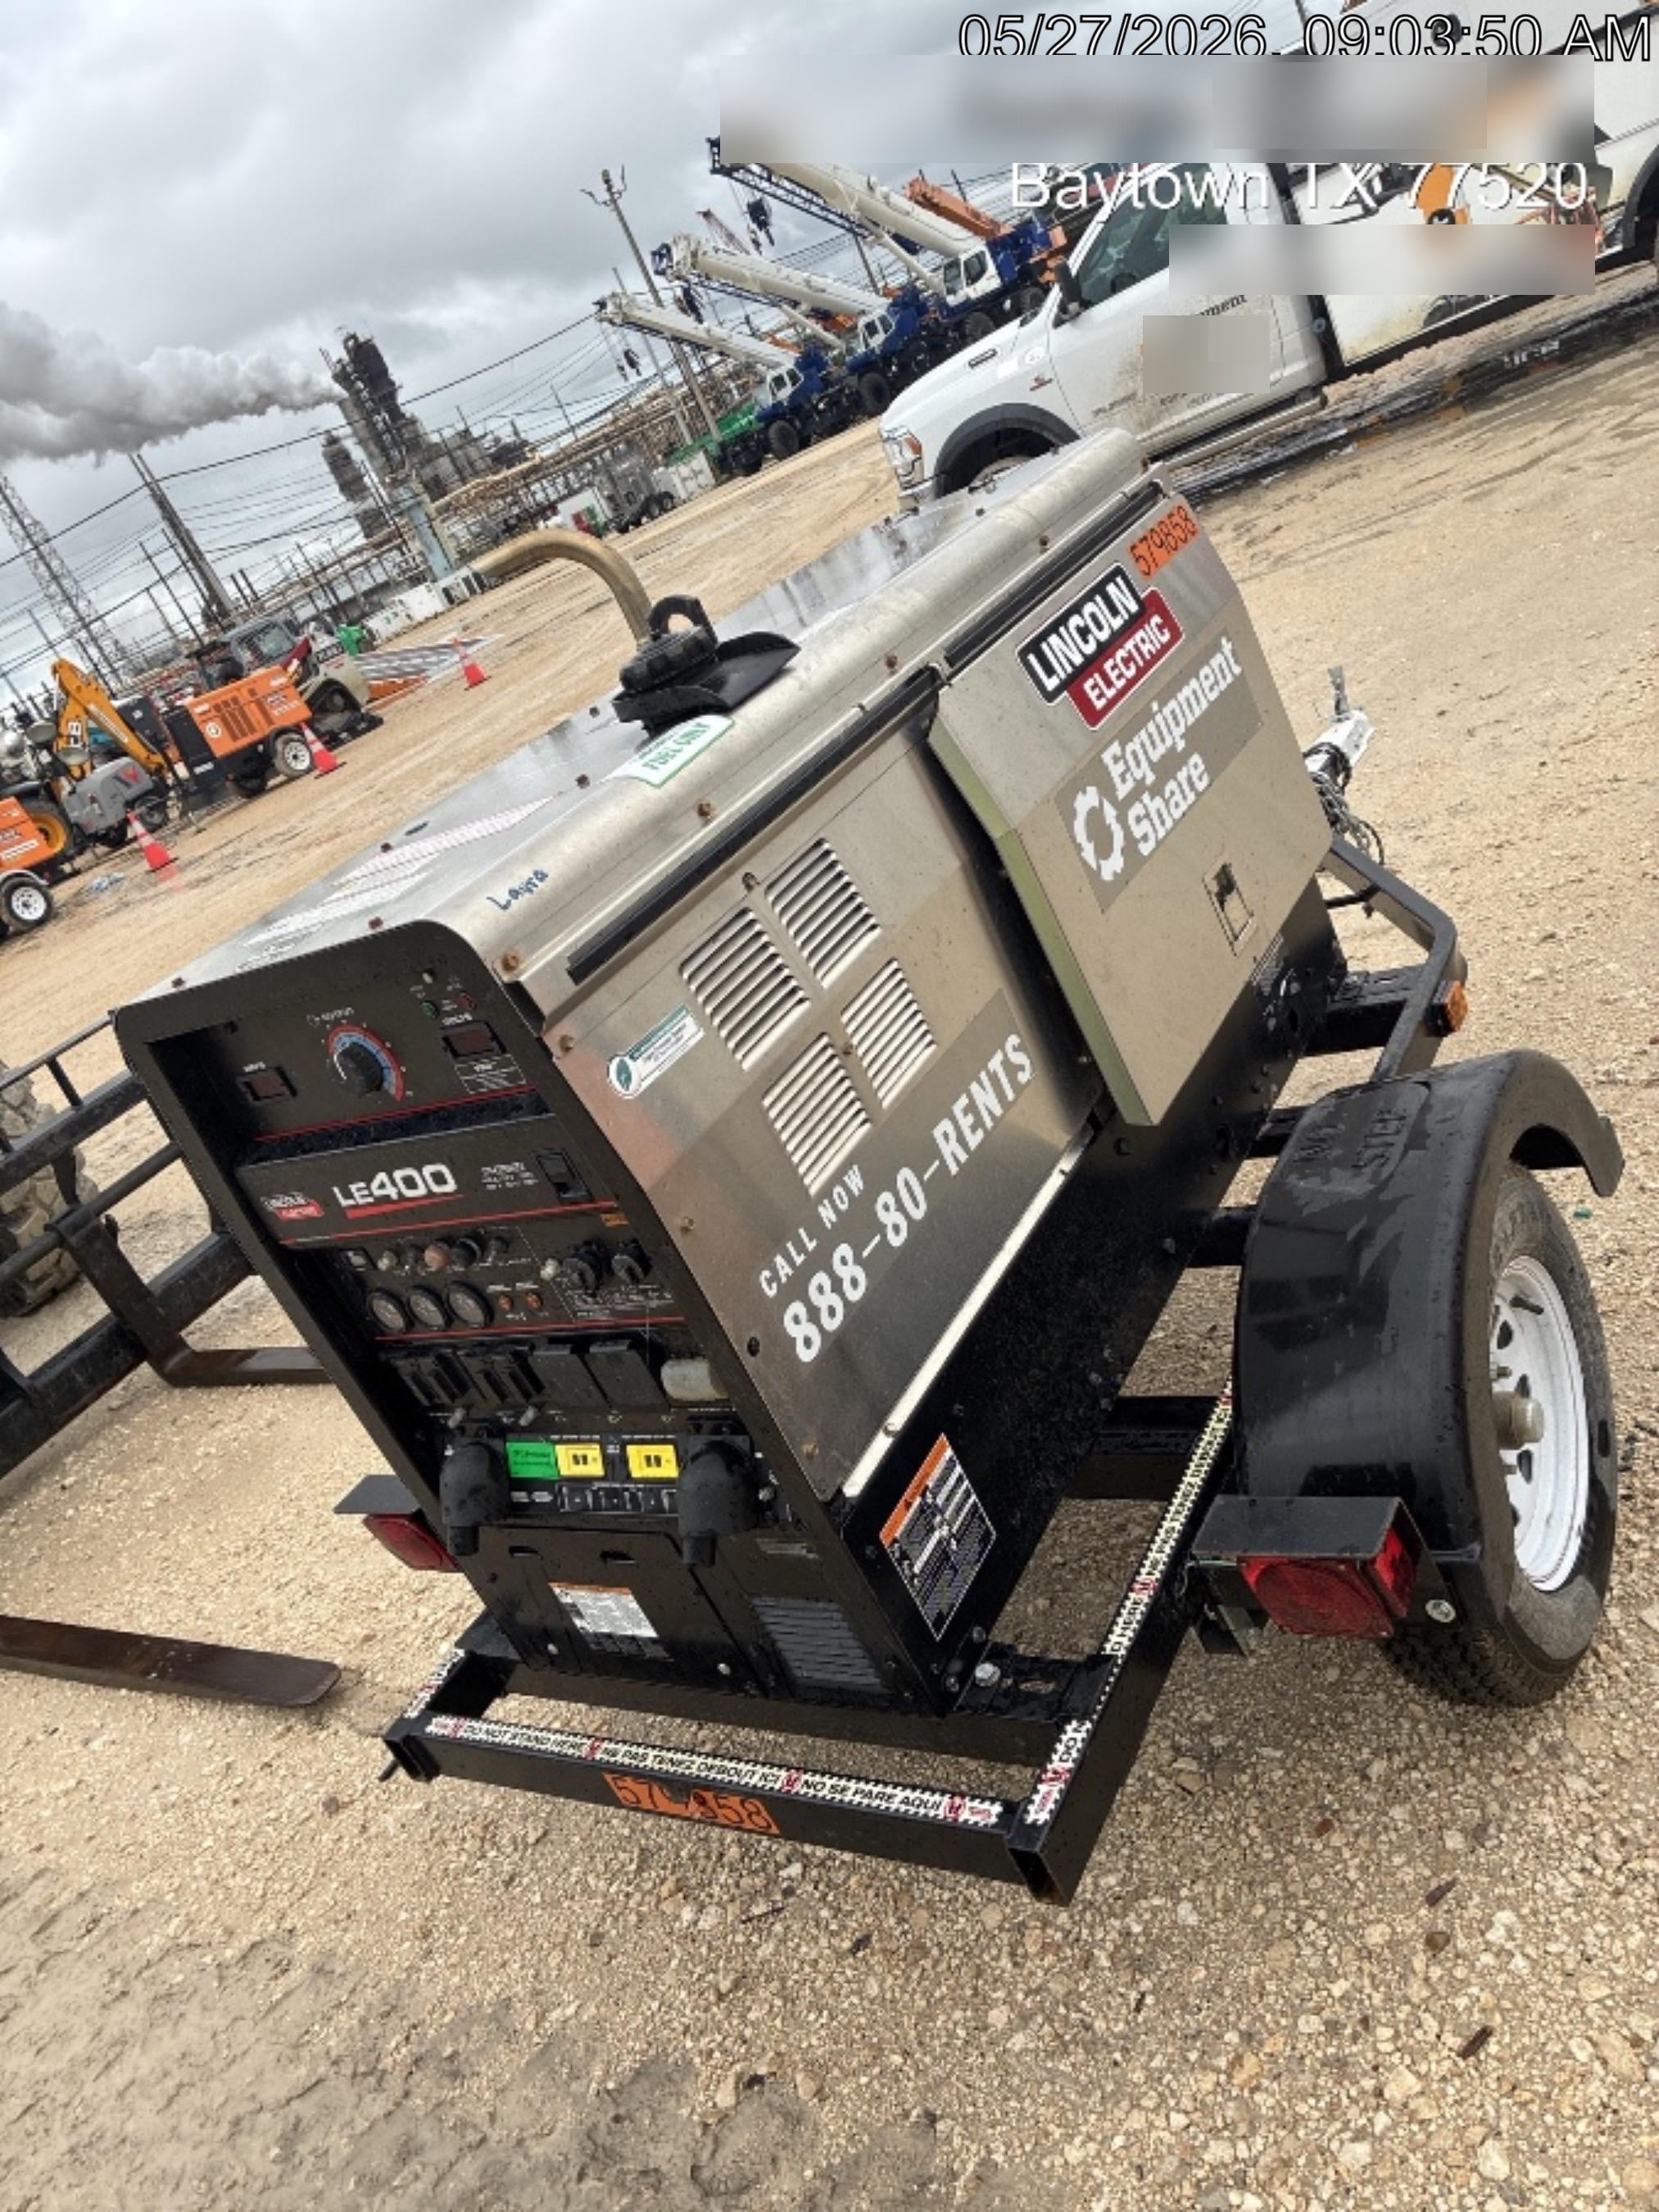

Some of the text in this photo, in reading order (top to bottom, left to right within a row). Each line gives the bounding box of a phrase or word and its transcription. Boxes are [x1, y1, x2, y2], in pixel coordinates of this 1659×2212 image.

[1027, 576, 1140, 692] LINCOLN
[1082, 614, 1171, 711] ELECTRIC
[1100, 635, 1243, 802] Equipment
[1127, 751, 1211, 856] Share
[332, 1163, 458, 1208] LE400
[759, 1164, 865, 1298] CALL NOW
[783, 1033, 1034, 1363] 888-80-RENTS
[696, 1761, 755, 1780] DEBOUT
[800, 1779, 827, 1793] NO
[828, 1783, 851, 1794] SE
[852, 1787, 898, 1803] PARE
